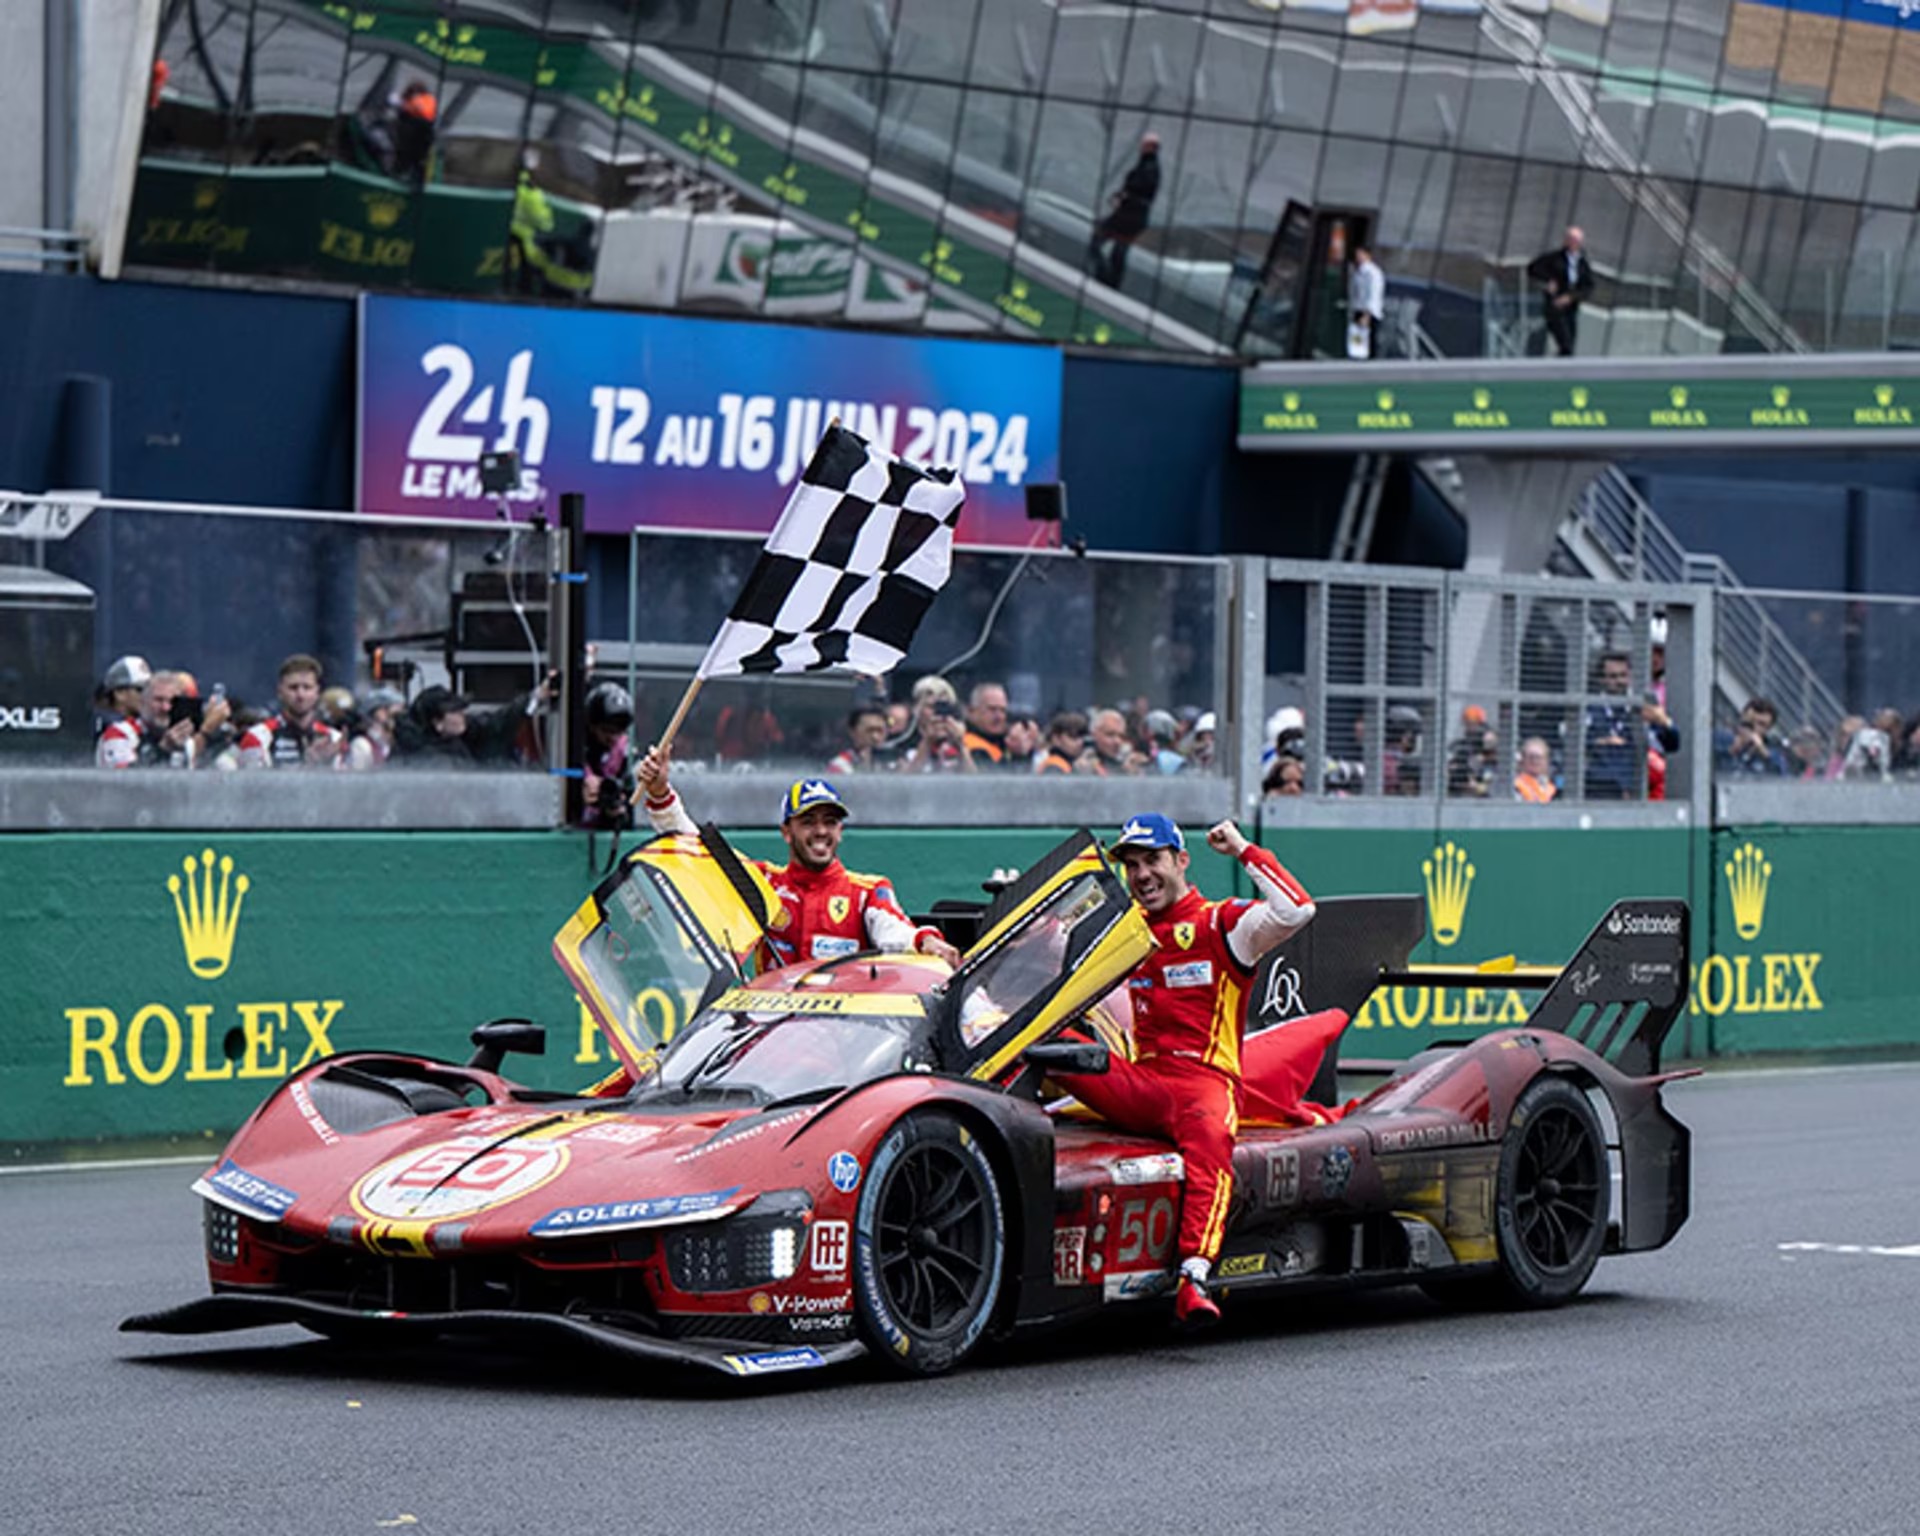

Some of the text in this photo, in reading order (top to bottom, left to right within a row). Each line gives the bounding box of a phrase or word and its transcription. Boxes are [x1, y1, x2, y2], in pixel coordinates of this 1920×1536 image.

[407, 343, 550, 465] 24h
[591, 385, 650, 464] 12
[654, 415, 714, 468] AU
[718, 393, 776, 471] 16
[907, 407, 1029, 485] 2024
[401, 464, 541, 502] LE MS
[0, 706, 61, 729] XUS
[1690, 953, 1823, 1015] OLEX
[64, 1000, 344, 1086] ROLEX
[401, 1150, 528, 1184] 50
[832, 1153, 857, 1192] hp
[547, 1203, 650, 1226] ADLER
[1117, 1197, 1174, 1264] 50
[1055, 1250, 1080, 1283] AR
[773, 1295, 848, 1313] V-Power
